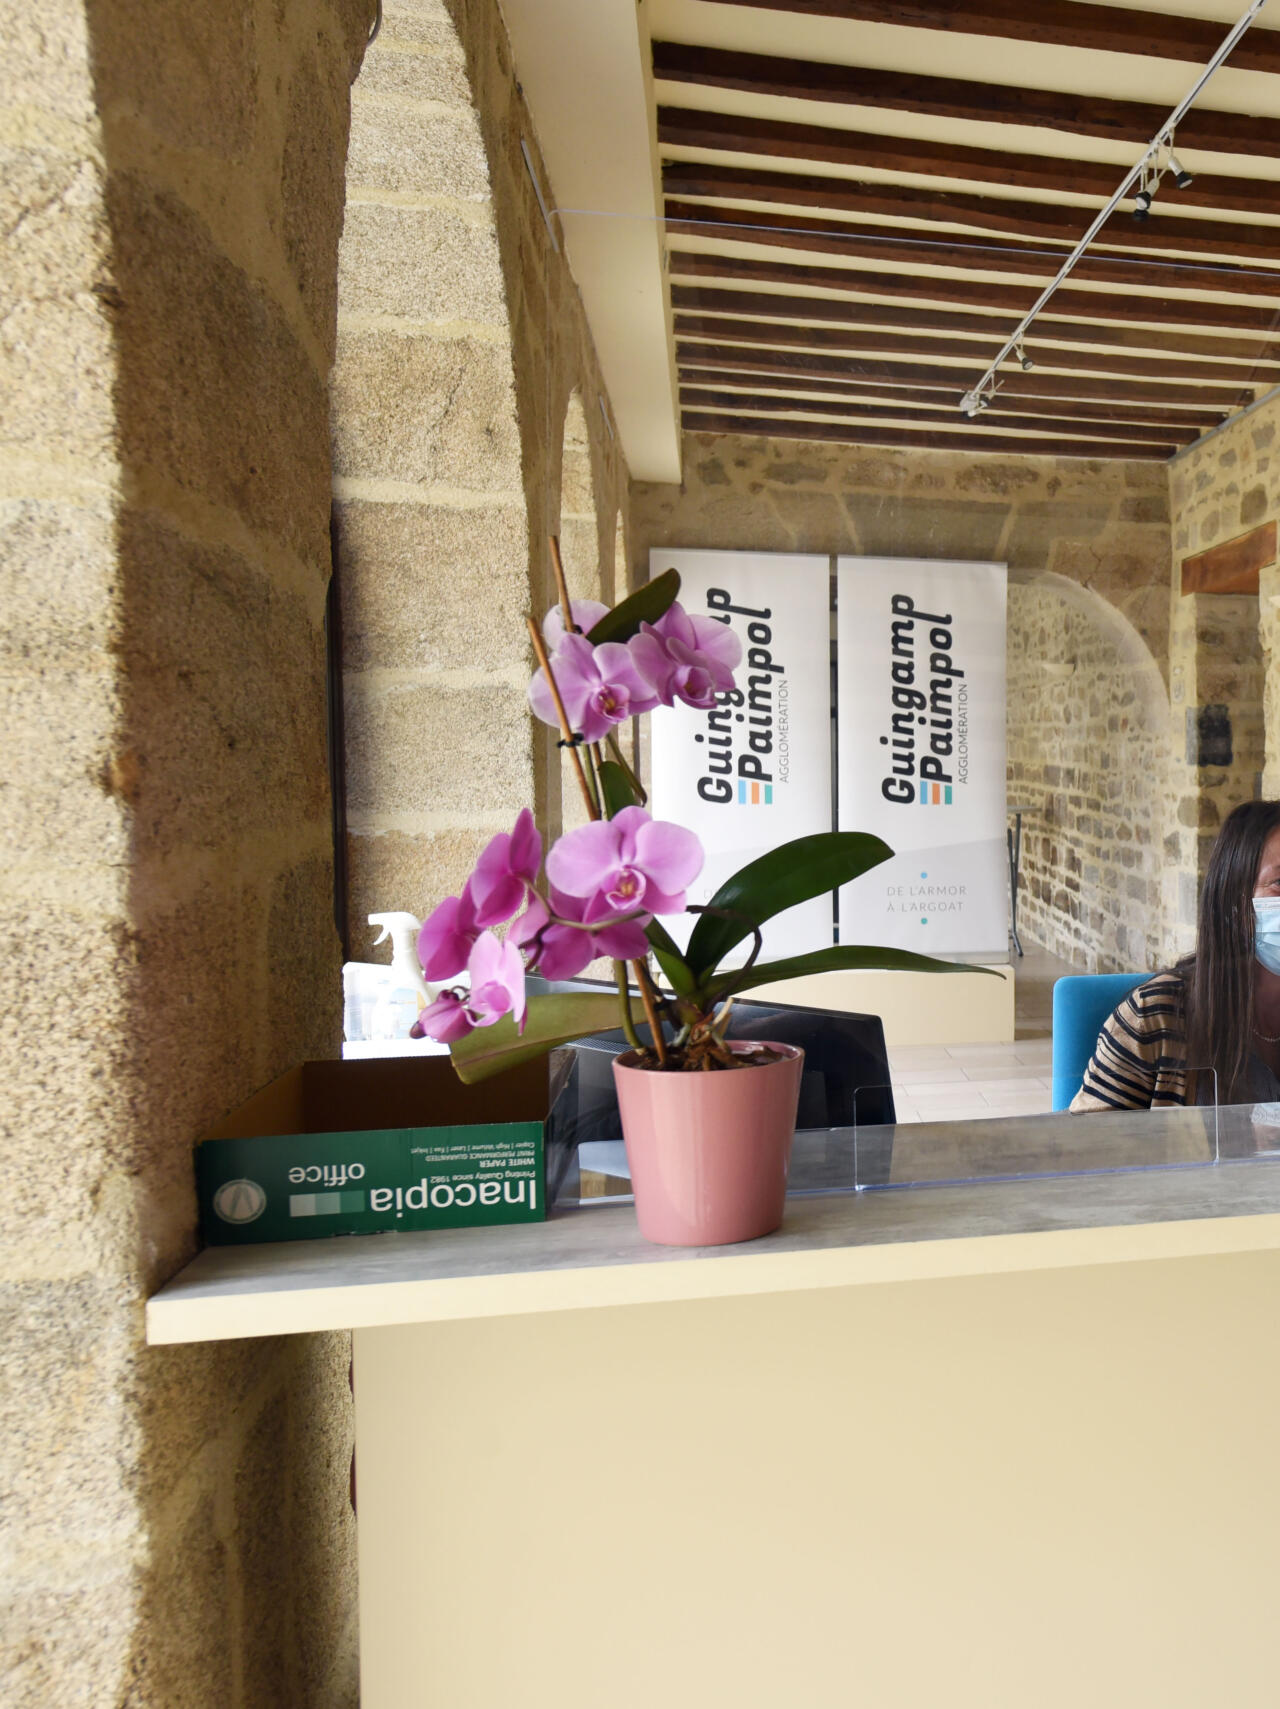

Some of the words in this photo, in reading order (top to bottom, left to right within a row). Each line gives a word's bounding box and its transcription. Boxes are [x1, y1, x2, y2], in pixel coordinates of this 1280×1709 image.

[695, 587, 744, 804] Guingp
[736, 607, 785, 782] Paimpol
[880, 594, 927, 804] Guingamp
[919, 613, 964, 783] Paimpol
[778, 679, 788, 783] AGGLOMÉRATION
[958, 683, 969, 784] AGGLOMÉRATION
[886, 886, 903, 897] DE
[909, 884, 968, 897] L'ARMOR
[886, 902, 895, 913] À
[901, 901, 964, 913] L'ARGOAT
[469, 1151, 516, 1159] PERFORMANCE
[479, 1159, 506, 1168] PAPER
[508, 1158, 535, 1166] WHITE
[288, 1162, 365, 1187] office
[452, 1174, 474, 1182] since
[475, 1172, 503, 1181] Quality
[505, 1170, 536, 1178] Printing
[369, 1178, 536, 1218] Inacopia
